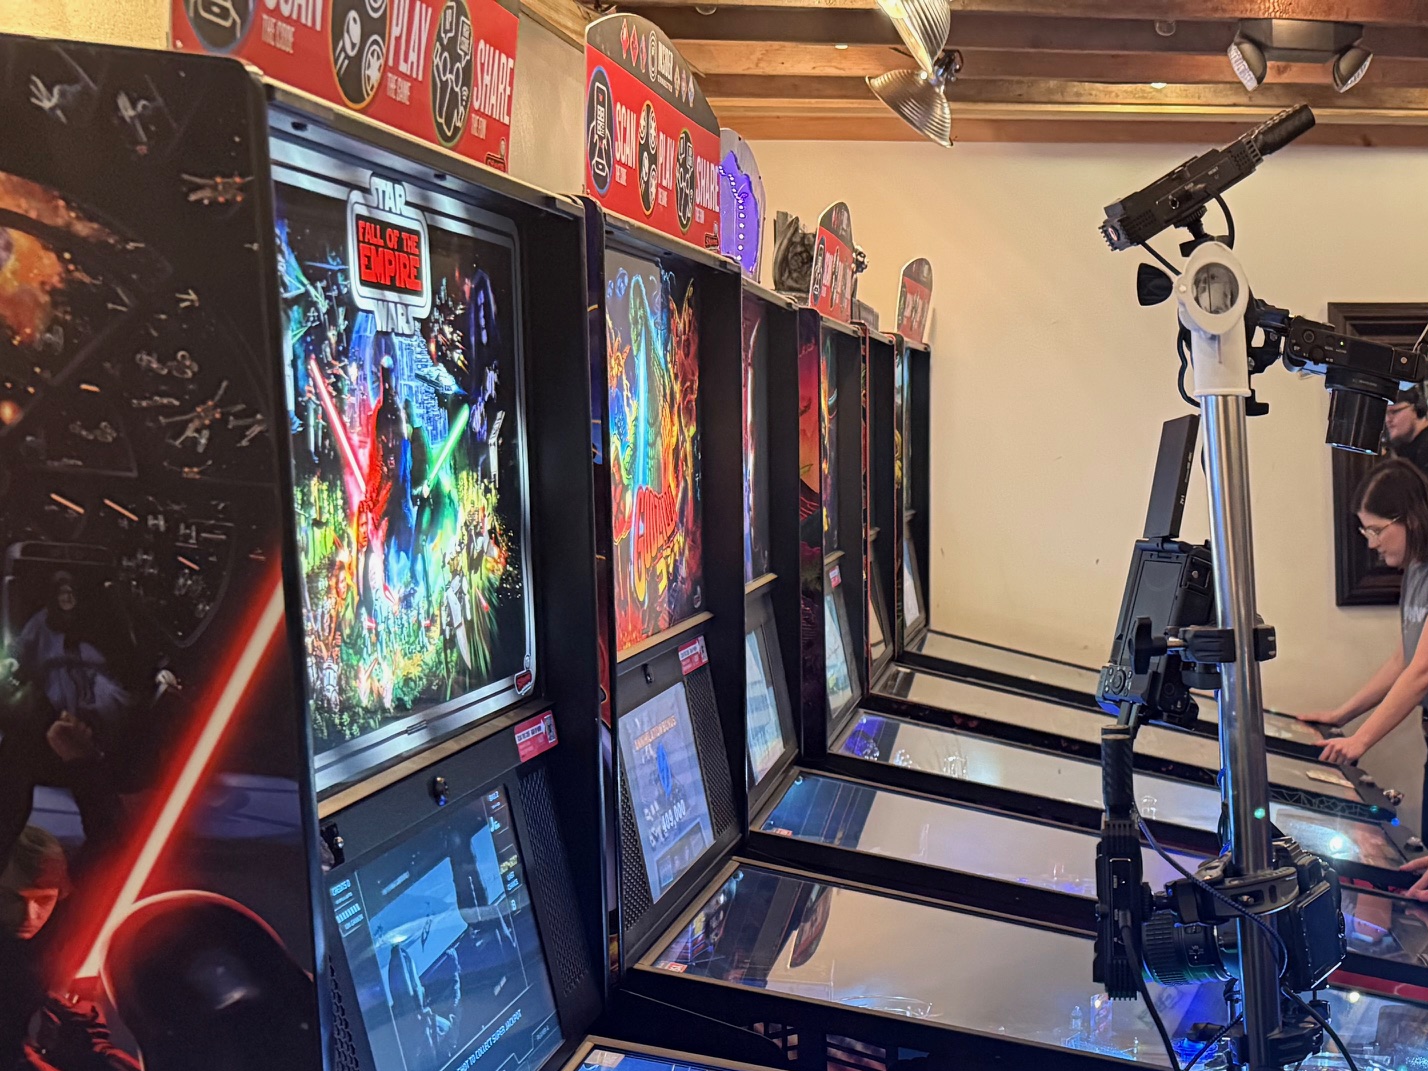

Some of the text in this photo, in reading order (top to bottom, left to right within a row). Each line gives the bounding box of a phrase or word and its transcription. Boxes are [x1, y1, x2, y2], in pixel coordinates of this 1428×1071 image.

[388, 0, 432, 82] PLAY
[472, 39, 515, 126] SHARE
[615, 101, 637, 170] SCAN
[658, 131, 675, 191] PLAY
[371, 176, 407, 216] STAR
[695, 155, 720, 213] SHARE
[358, 220, 419, 255] FALL OF THE
[359, 244, 422, 292] EMPIRE
[374, 300, 416, 335] WARS
[468, 1052, 477, 1067] TO
[474, 1036, 494, 1060] COLLECT
[490, 1024, 506, 1044] SUPER
[502, 1008, 523, 1031] JACKPOT
